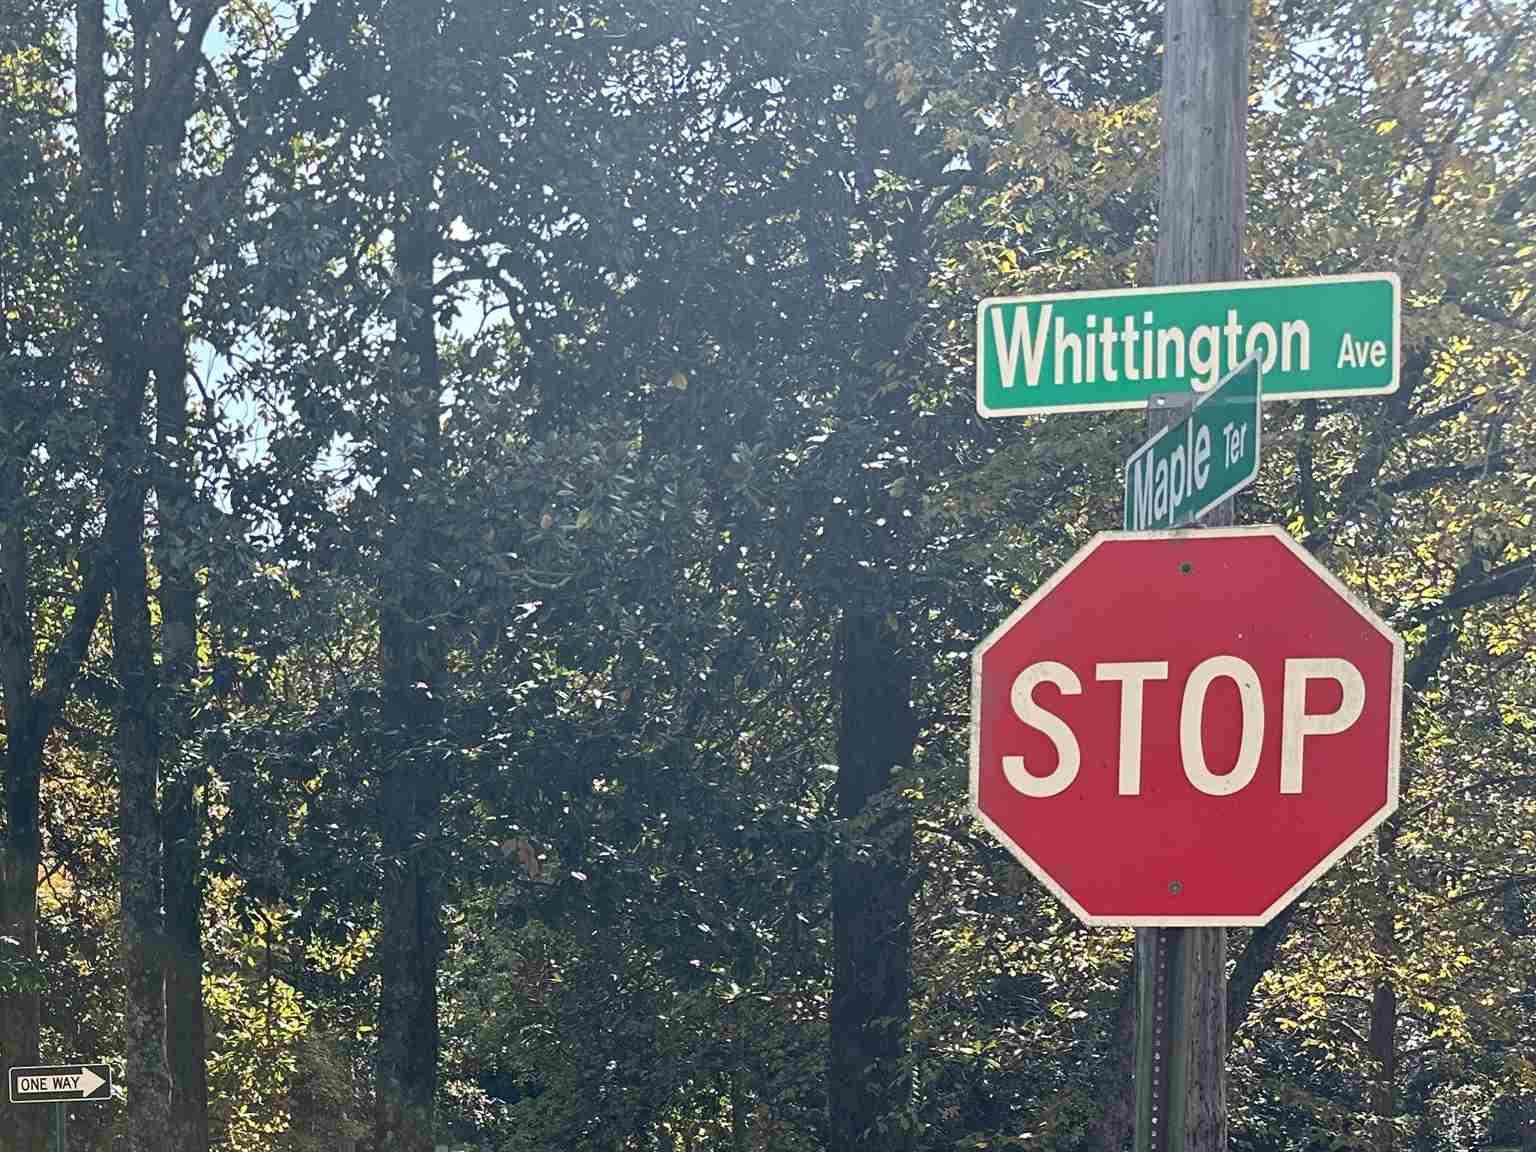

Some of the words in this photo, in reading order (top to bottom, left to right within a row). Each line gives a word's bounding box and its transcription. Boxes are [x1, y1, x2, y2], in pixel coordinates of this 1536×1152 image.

[990, 303, 1311, 392] Whittington
[1336, 332, 1388, 369] Ave
[1133, 416, 1212, 530] Maple
[1223, 421, 1248, 470] Ter
[1001, 655, 1367, 798] STOP
[20, 1078, 48, 1091] ONE
[52, 1076, 81, 1089] WAY
